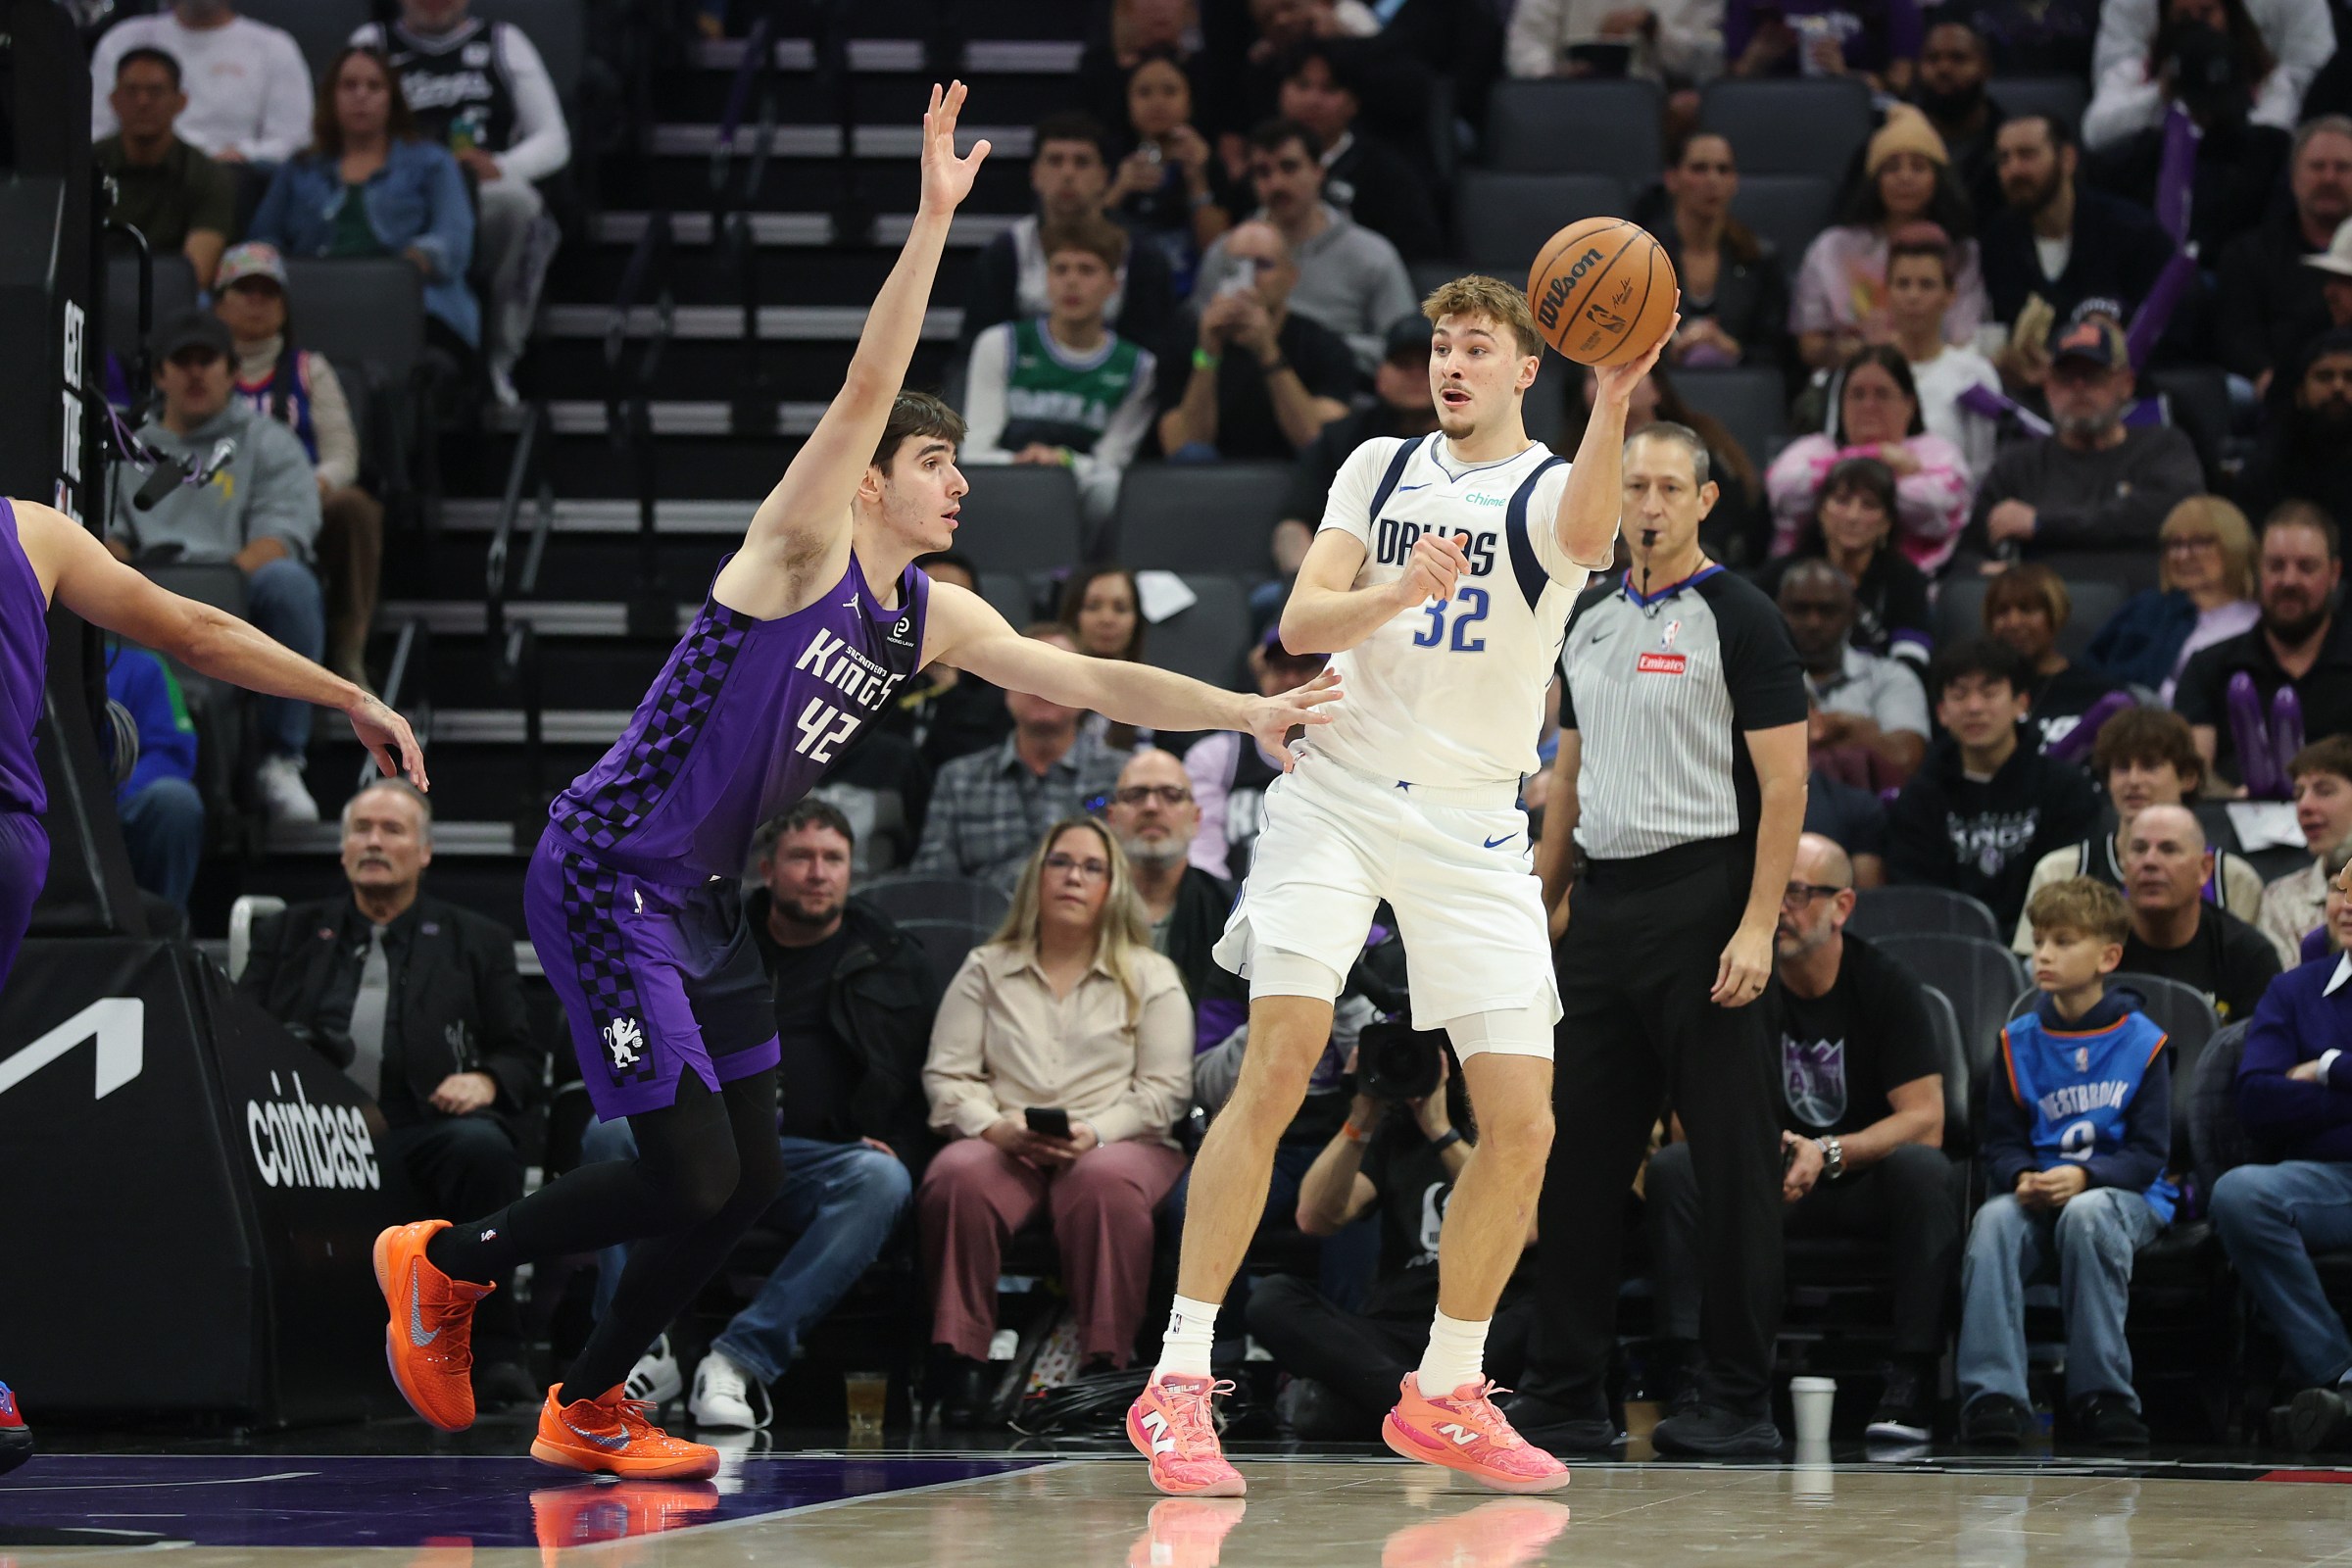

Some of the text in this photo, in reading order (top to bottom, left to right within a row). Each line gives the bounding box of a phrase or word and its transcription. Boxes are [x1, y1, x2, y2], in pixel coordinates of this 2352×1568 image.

[1538, 248, 1604, 330] Wilson
[1465, 492, 1506, 507] chime
[1377, 518, 1497, 576] DAAS
[1412, 586, 1490, 653] 32
[795, 627, 906, 710] KINGS
[1640, 656, 1685, 671] Emirates
[795, 697, 861, 763] 42
[247, 1069, 380, 1191] coinbase
